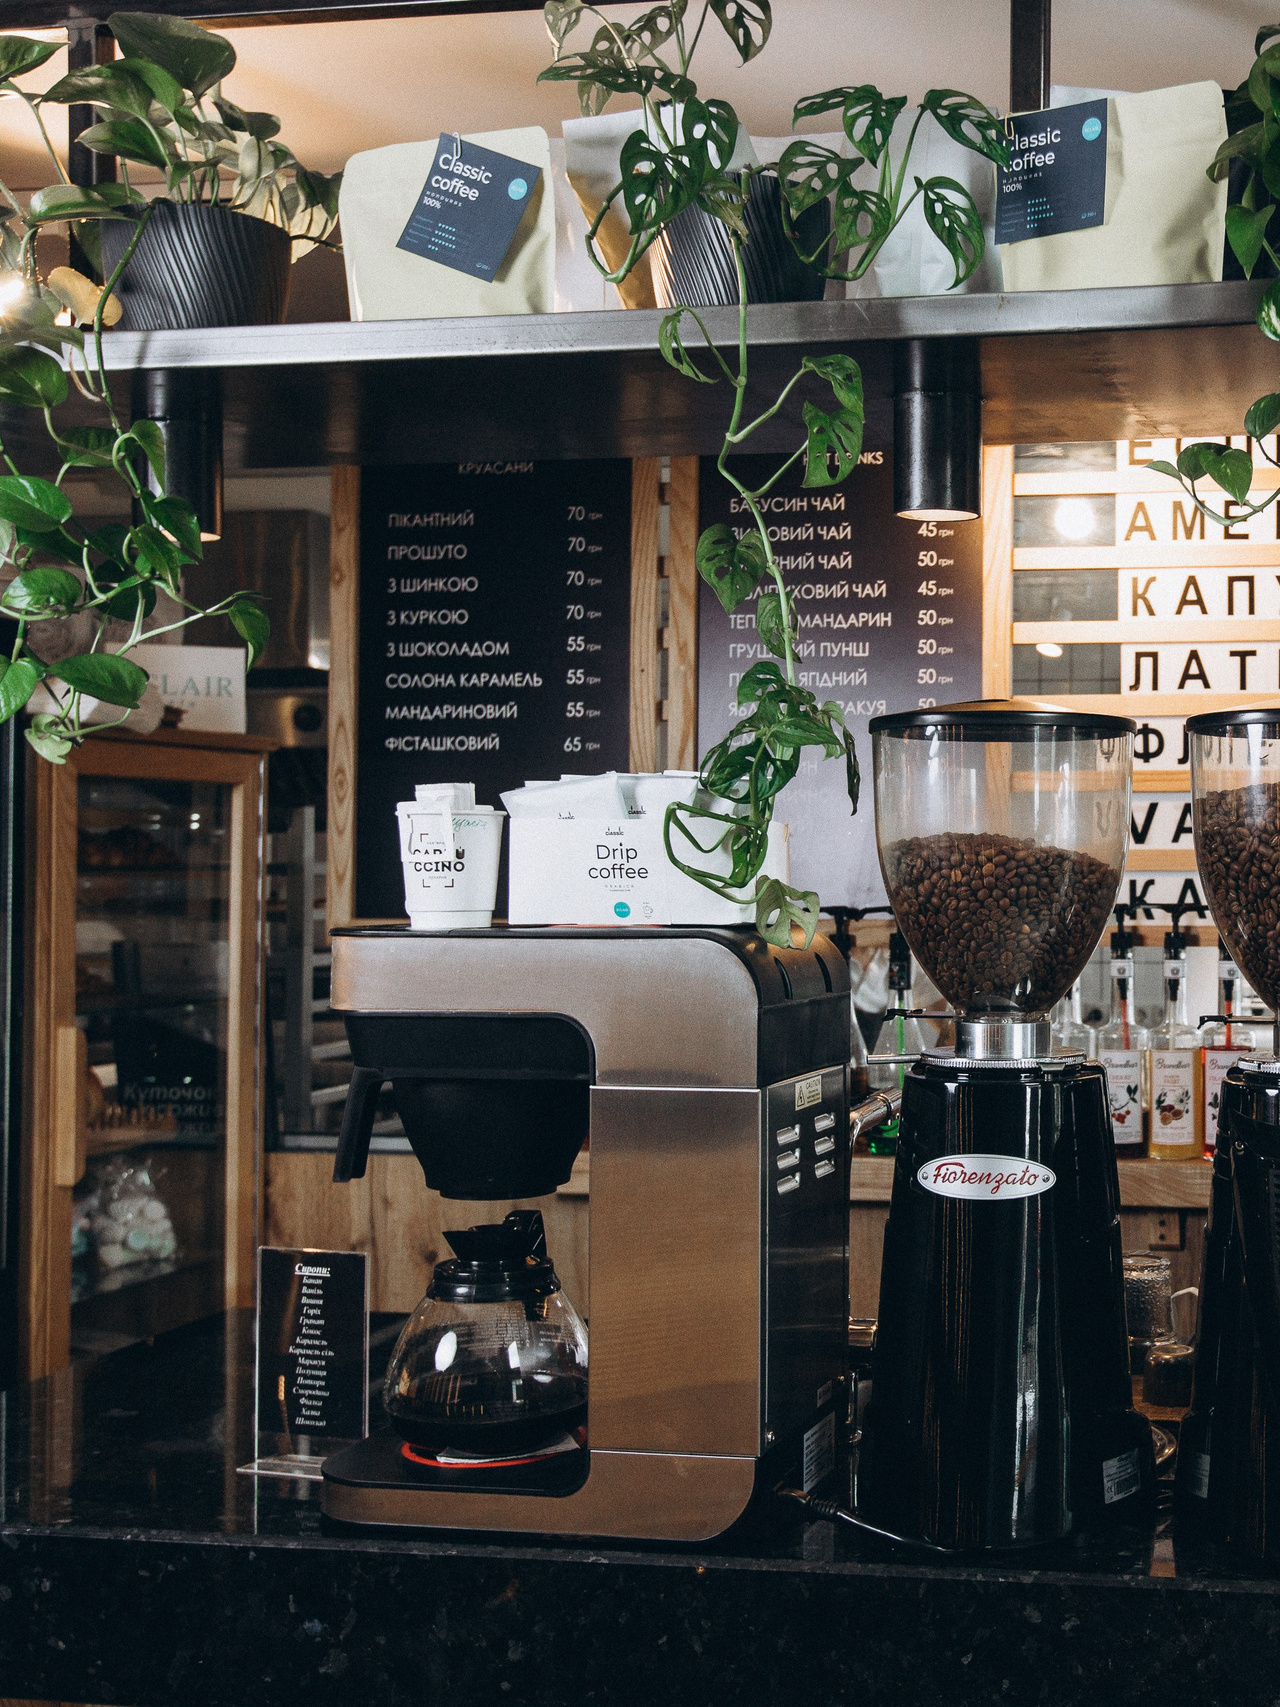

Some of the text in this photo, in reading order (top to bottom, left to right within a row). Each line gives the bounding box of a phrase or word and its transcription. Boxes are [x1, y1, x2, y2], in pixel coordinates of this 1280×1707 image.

[438, 153, 492, 185] Classic
[1003, 151, 1055, 174] coffee
[431, 175, 480, 201] coffee
[1002, 183, 1023, 194] 100%
[422, 196, 441, 209] 100%
[458, 461, 533, 475] КРУАСАНИ
[811, 493, 846, 512] ЧАЙ
[387, 509, 475, 528] ПІКАНТНИЙ
[567, 506, 585, 521] 70
[731, 521, 954, 542] ЗИОВИЙ ЧАЙ 45 грн
[387, 544, 468, 560] ПРОШУТО
[567, 537, 586, 552] 70
[818, 551, 852, 570] ЧАЙ
[917, 551, 938, 567] 50
[938, 558, 954, 567] грн
[401, 576, 479, 593] ШИНКОЮ
[566, 570, 585, 586] 70
[852, 580, 887, 598] ЧАЙ
[917, 580, 938, 596] 45
[938, 587, 954, 597] грн
[400, 609, 469, 625] КУРКОЮ
[566, 605, 584, 620] 70
[799, 612, 892, 630] МАНДАРИН
[917, 609, 938, 626] 50
[938, 616, 954, 626] грн
[399, 641, 510, 657] ШОКОЛАДОМ
[566, 636, 585, 651] 55
[819, 642, 870, 658] ПУНШ
[917, 638, 938, 656] 50
[938, 645, 954, 656] грн
[152, 674, 233, 698] LAIR
[385, 673, 456, 689] СОЛОНА
[459, 672, 543, 688] КАРАМЕЛЬ
[566, 669, 585, 685] 55
[799, 668, 954, 688] ЯГІДНИЙ 50 грн
[385, 702, 518, 721] МАНДАРИНОВИЙ
[566, 702, 585, 718] 55
[385, 733, 500, 751] ФІСТАШКОВИЙ
[563, 737, 581, 752] 65
[596, 842, 638, 863] Drip
[414, 861, 466, 872] CCINO
[588, 863, 649, 879] coffee
[932, 1162, 1040, 1195] Fiorenzato
[295, 1263, 331, 1275] Сиропи:
[303, 1306, 321, 1316] Горіх
[288, 1345, 320, 1355] Карамель
[295, 1336, 328, 1346] Карамель
